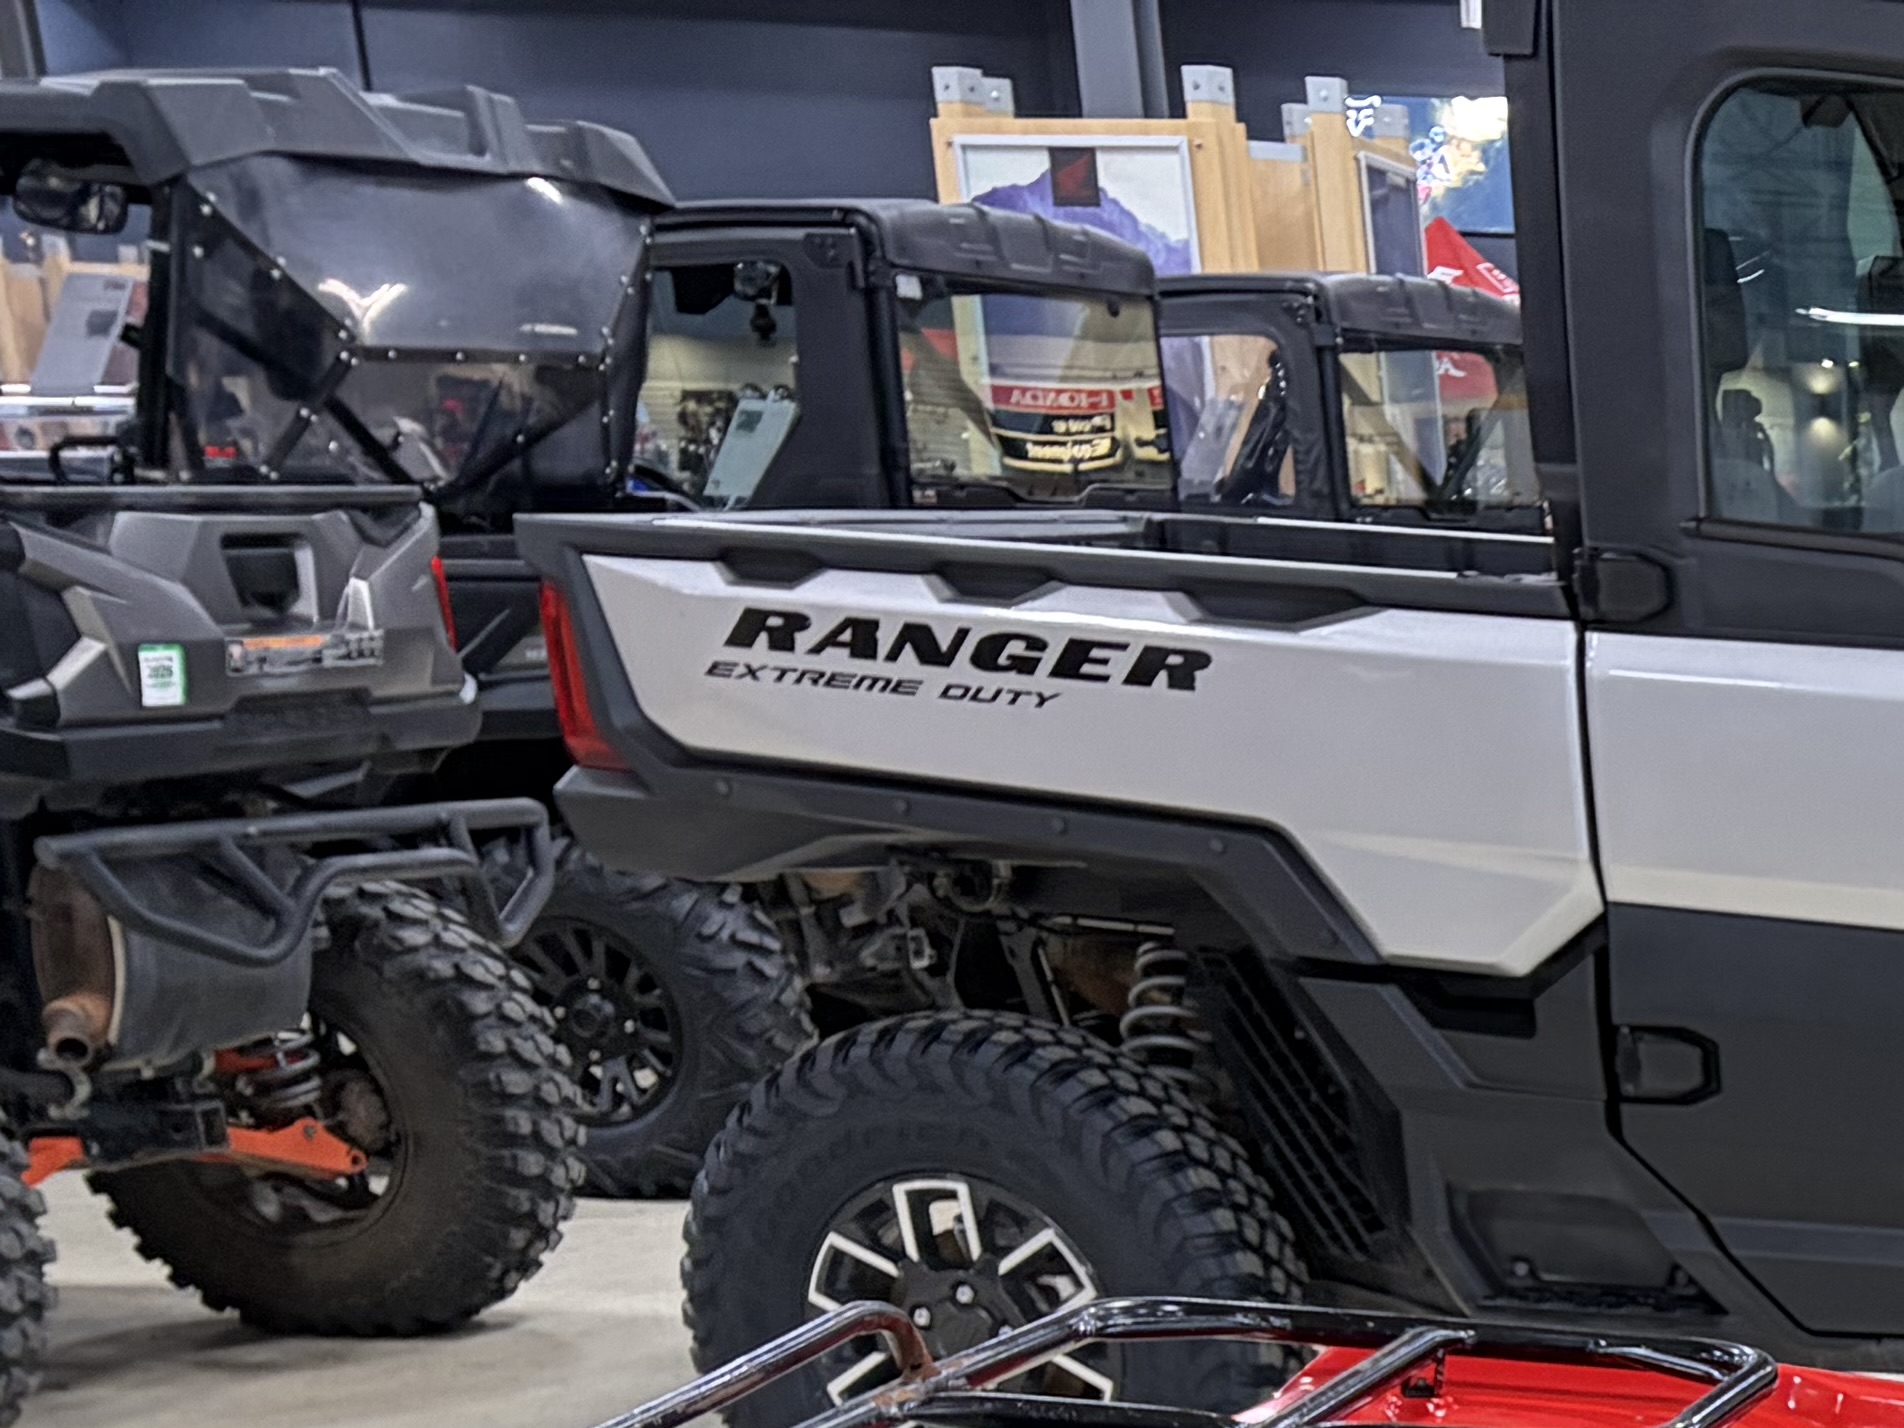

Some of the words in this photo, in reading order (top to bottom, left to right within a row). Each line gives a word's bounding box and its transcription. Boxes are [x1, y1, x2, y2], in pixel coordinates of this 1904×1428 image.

[723, 607, 1212, 691] RANGER
[704, 660, 924, 697] EXTREME
[937, 681, 1063, 709] DUTY
